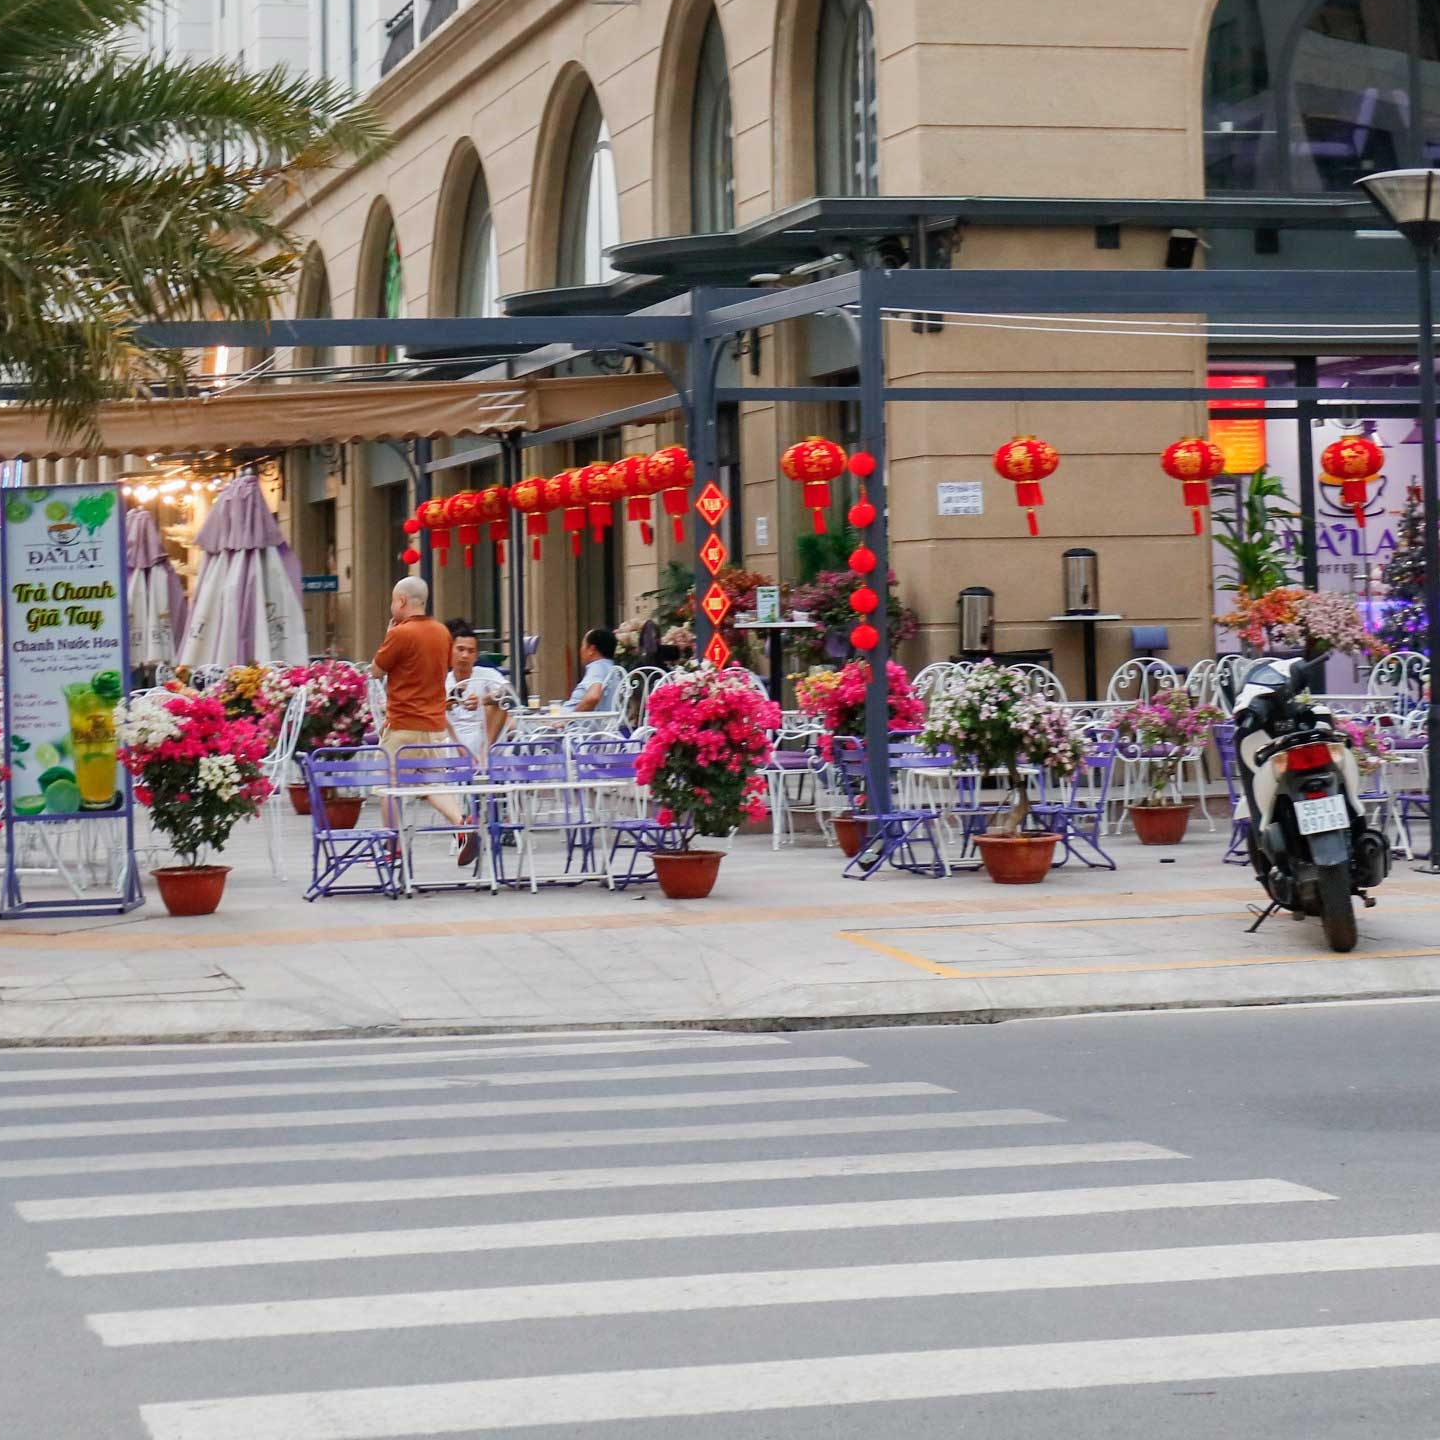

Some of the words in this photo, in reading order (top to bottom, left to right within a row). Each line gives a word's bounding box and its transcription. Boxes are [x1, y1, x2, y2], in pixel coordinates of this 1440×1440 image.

[52, 580, 116, 601] Chanh
[26, 607, 62, 633] Giã
[64, 605, 104, 631] Tay
[13, 639, 54, 652] Chanh
[93, 637, 119, 649] Hoa
